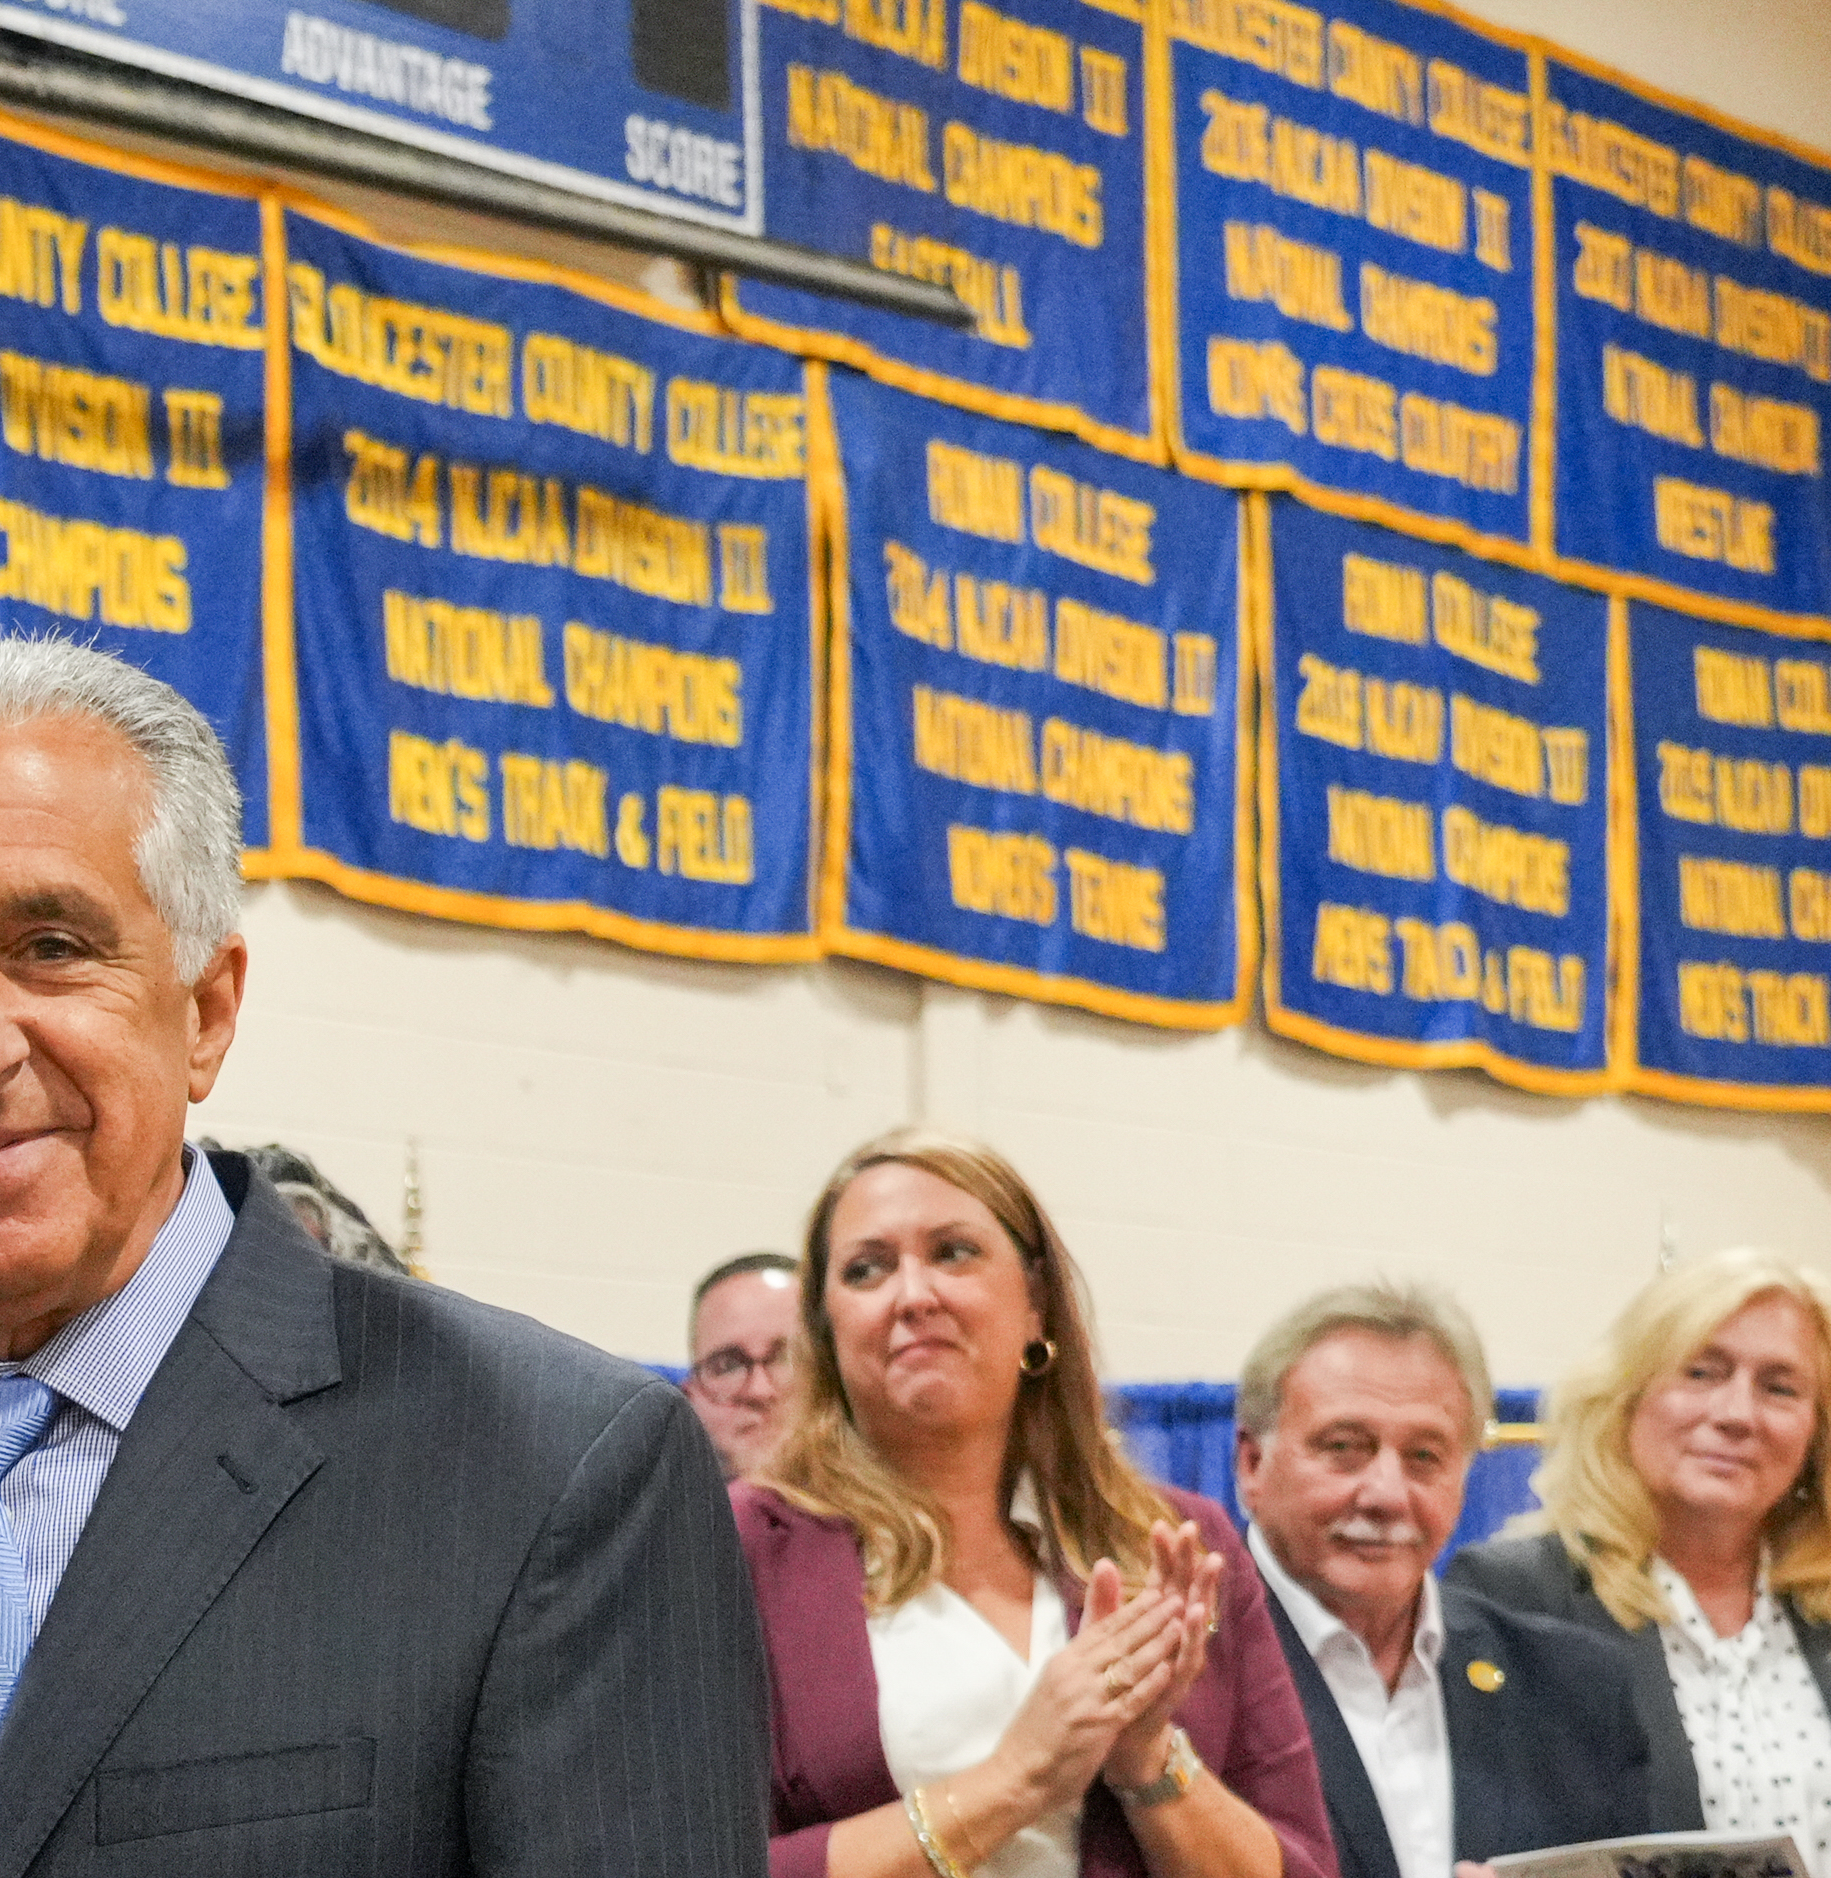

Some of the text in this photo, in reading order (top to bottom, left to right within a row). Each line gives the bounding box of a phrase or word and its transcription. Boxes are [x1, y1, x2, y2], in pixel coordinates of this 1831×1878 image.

[282, 11, 494, 132] ADVANTAGE
[623, 114, 742, 209] SCORE
[96, 227, 266, 350] COLLEGE
[163, 388, 231, 490] III
[615, 792, 649, 870] &
